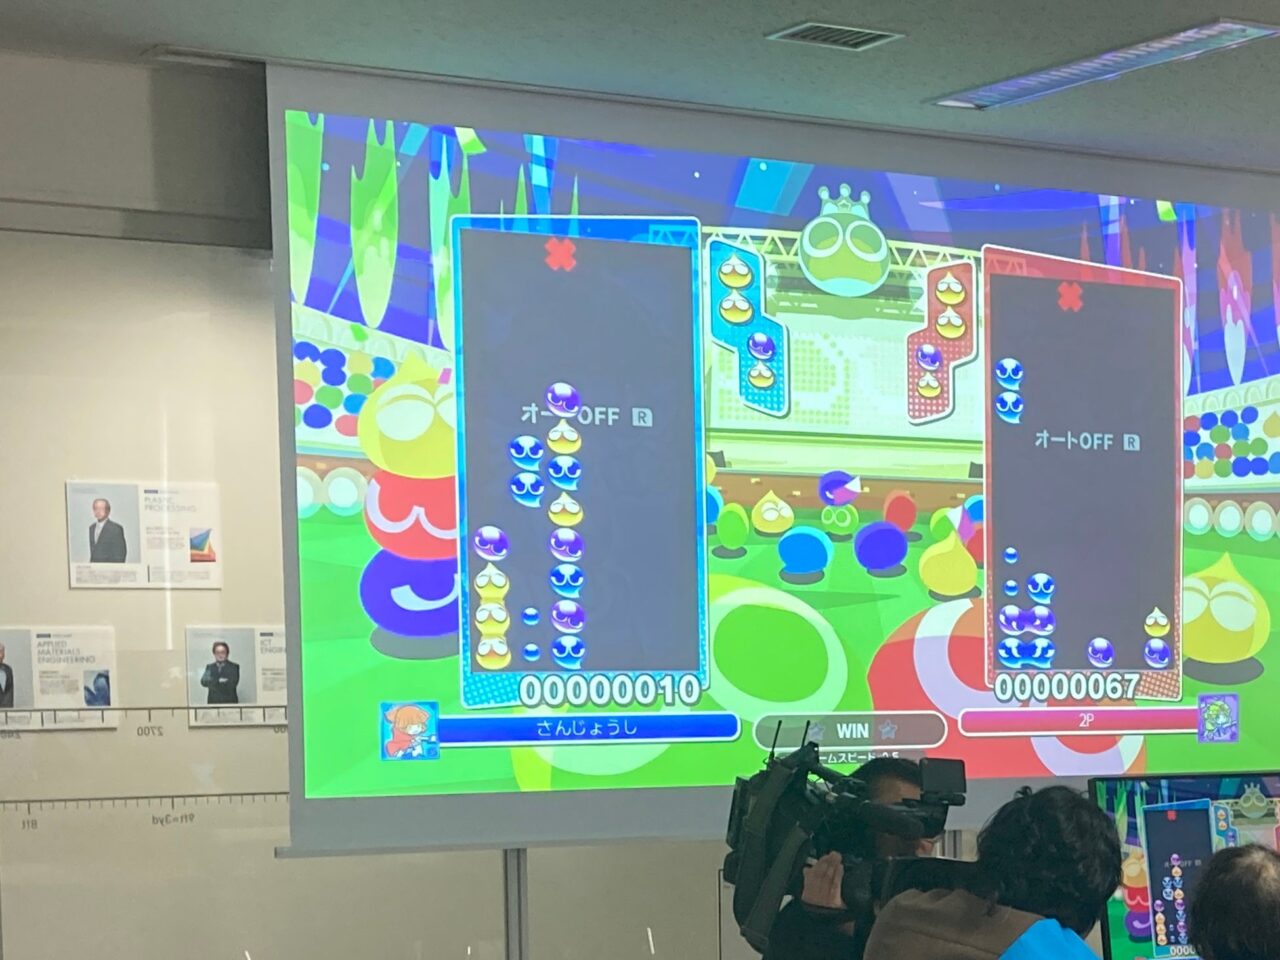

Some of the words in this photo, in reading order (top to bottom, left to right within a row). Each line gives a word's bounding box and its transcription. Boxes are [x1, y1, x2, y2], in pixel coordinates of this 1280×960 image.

[521, 402, 620, 426] オーOFF
[632, 407, 653, 427] R
[1035, 429, 1113, 450] オートOFF
[1123, 433, 1140, 451] R
[519, 673, 701, 708] 00000010
[994, 671, 1141, 702] 00000067
[536, 719, 638, 737] さんじょうし
[836, 723, 869, 739] WIN
[1079, 713, 1094, 727] 2P
